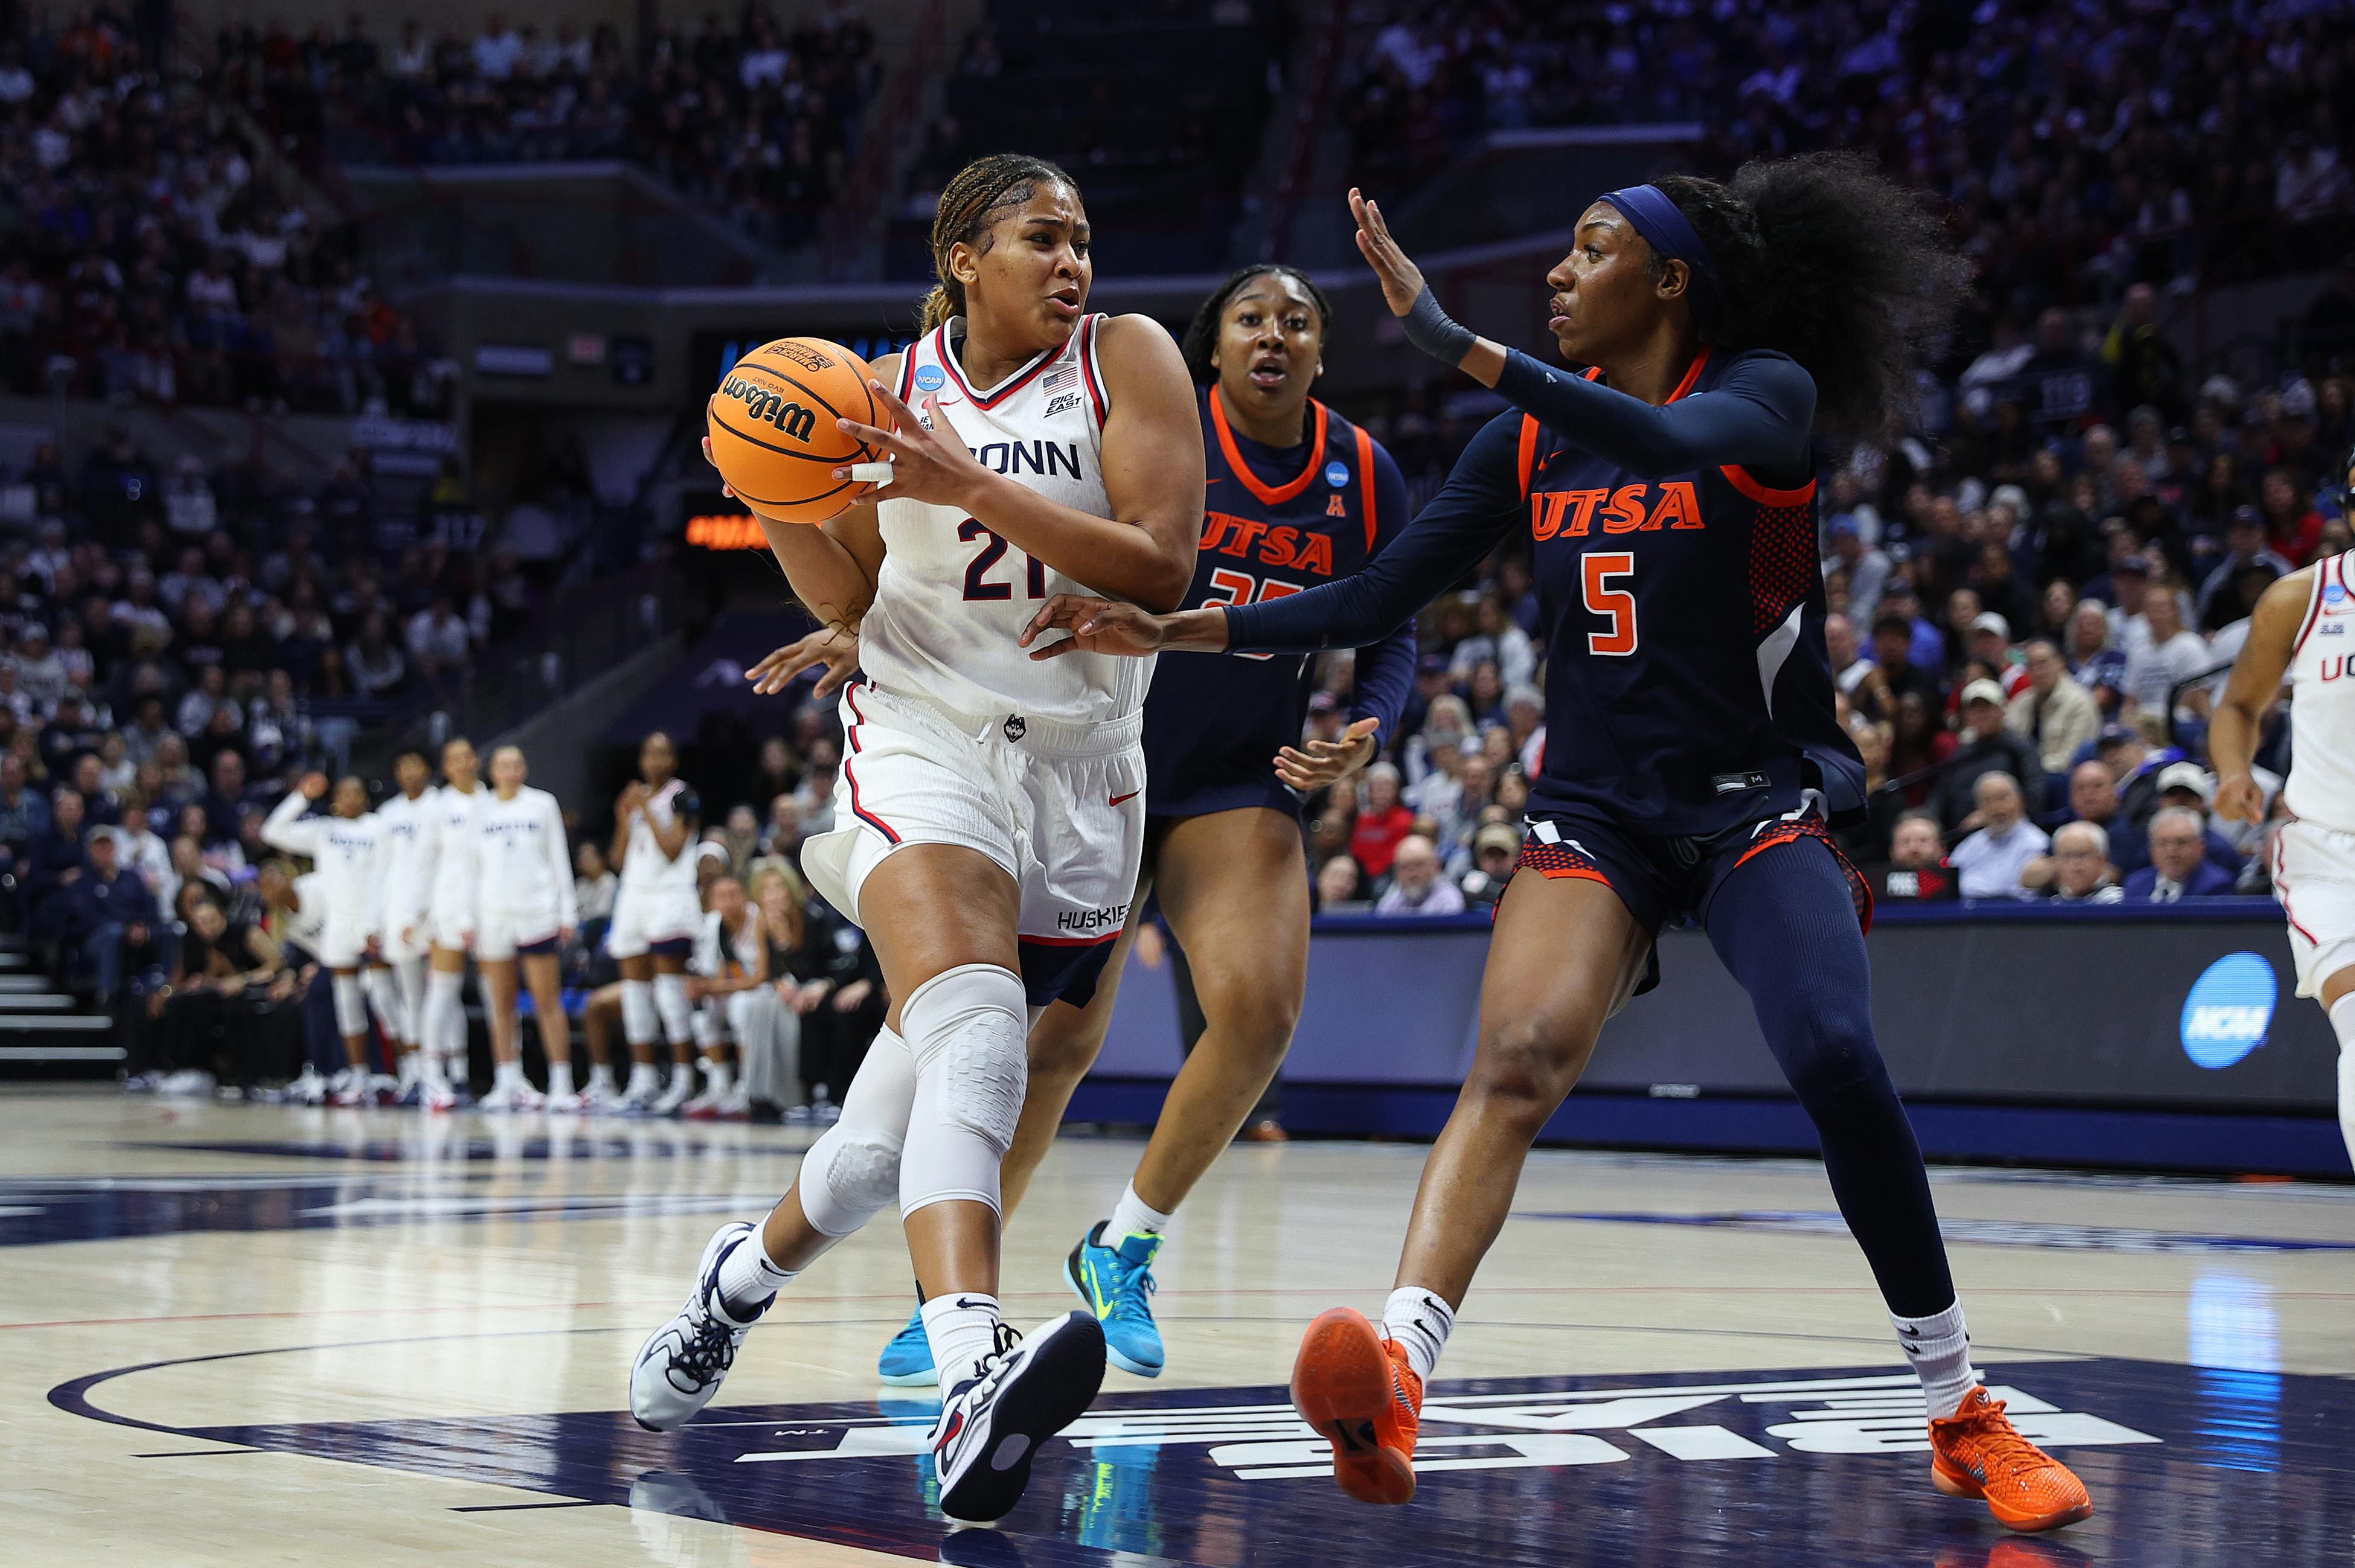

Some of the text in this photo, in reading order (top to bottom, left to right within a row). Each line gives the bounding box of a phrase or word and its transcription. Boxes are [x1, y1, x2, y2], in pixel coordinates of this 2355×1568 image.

[752, 376, 784, 394] EVO NXT
[918, 376, 943, 385] NCAA
[723, 375, 816, 444] Wilson
[1046, 397, 1082, 414] EAST
[1049, 392, 1075, 406] BIG
[969, 440, 1082, 481] ONN
[1531, 481, 1706, 542] UTSA
[957, 517, 1046, 601] 21
[1580, 551, 1638, 656] 5
[1750, 775, 1763, 783] M
